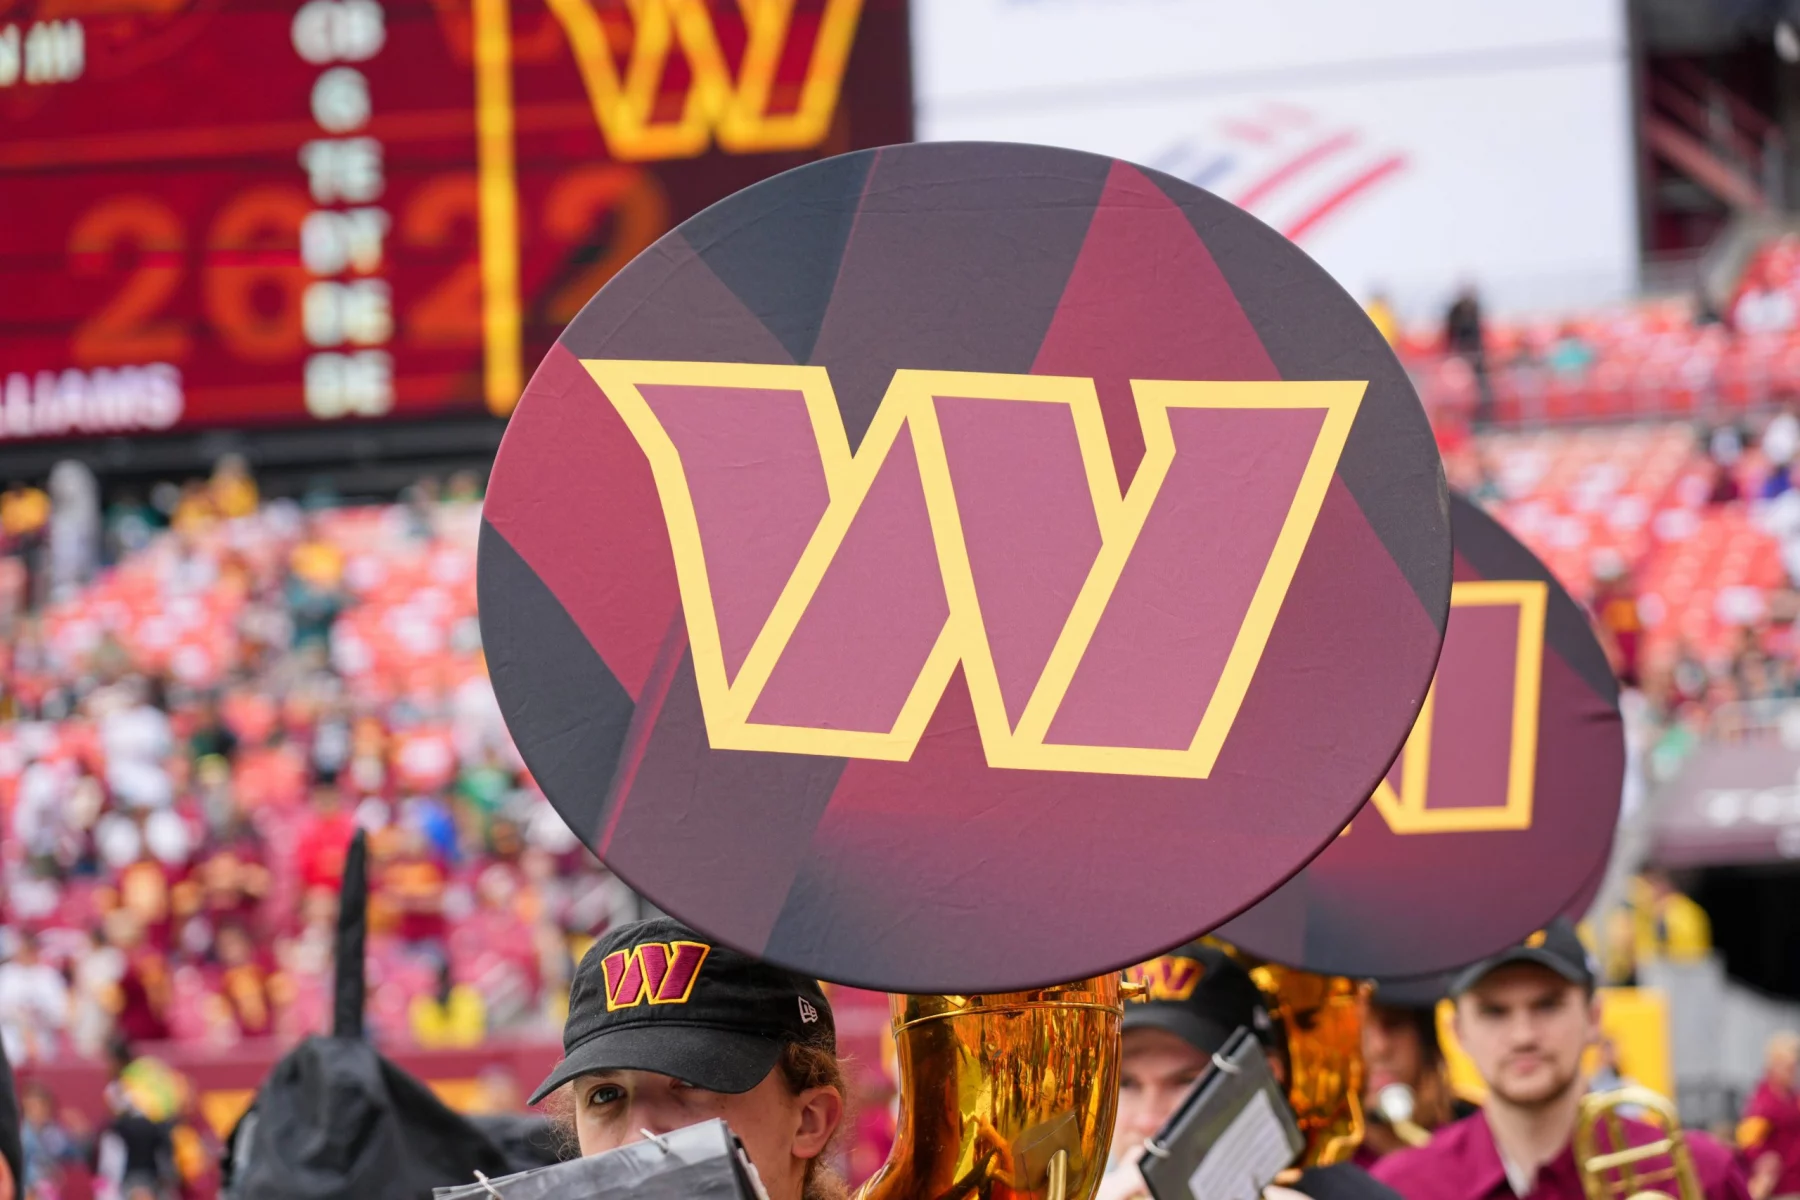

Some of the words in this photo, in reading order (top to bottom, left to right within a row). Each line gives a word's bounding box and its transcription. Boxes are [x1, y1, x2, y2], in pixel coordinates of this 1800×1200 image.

[0, 364, 183, 436] LLIAMS
[580, 358, 1369, 780] W
[601, 940, 710, 1012] W
